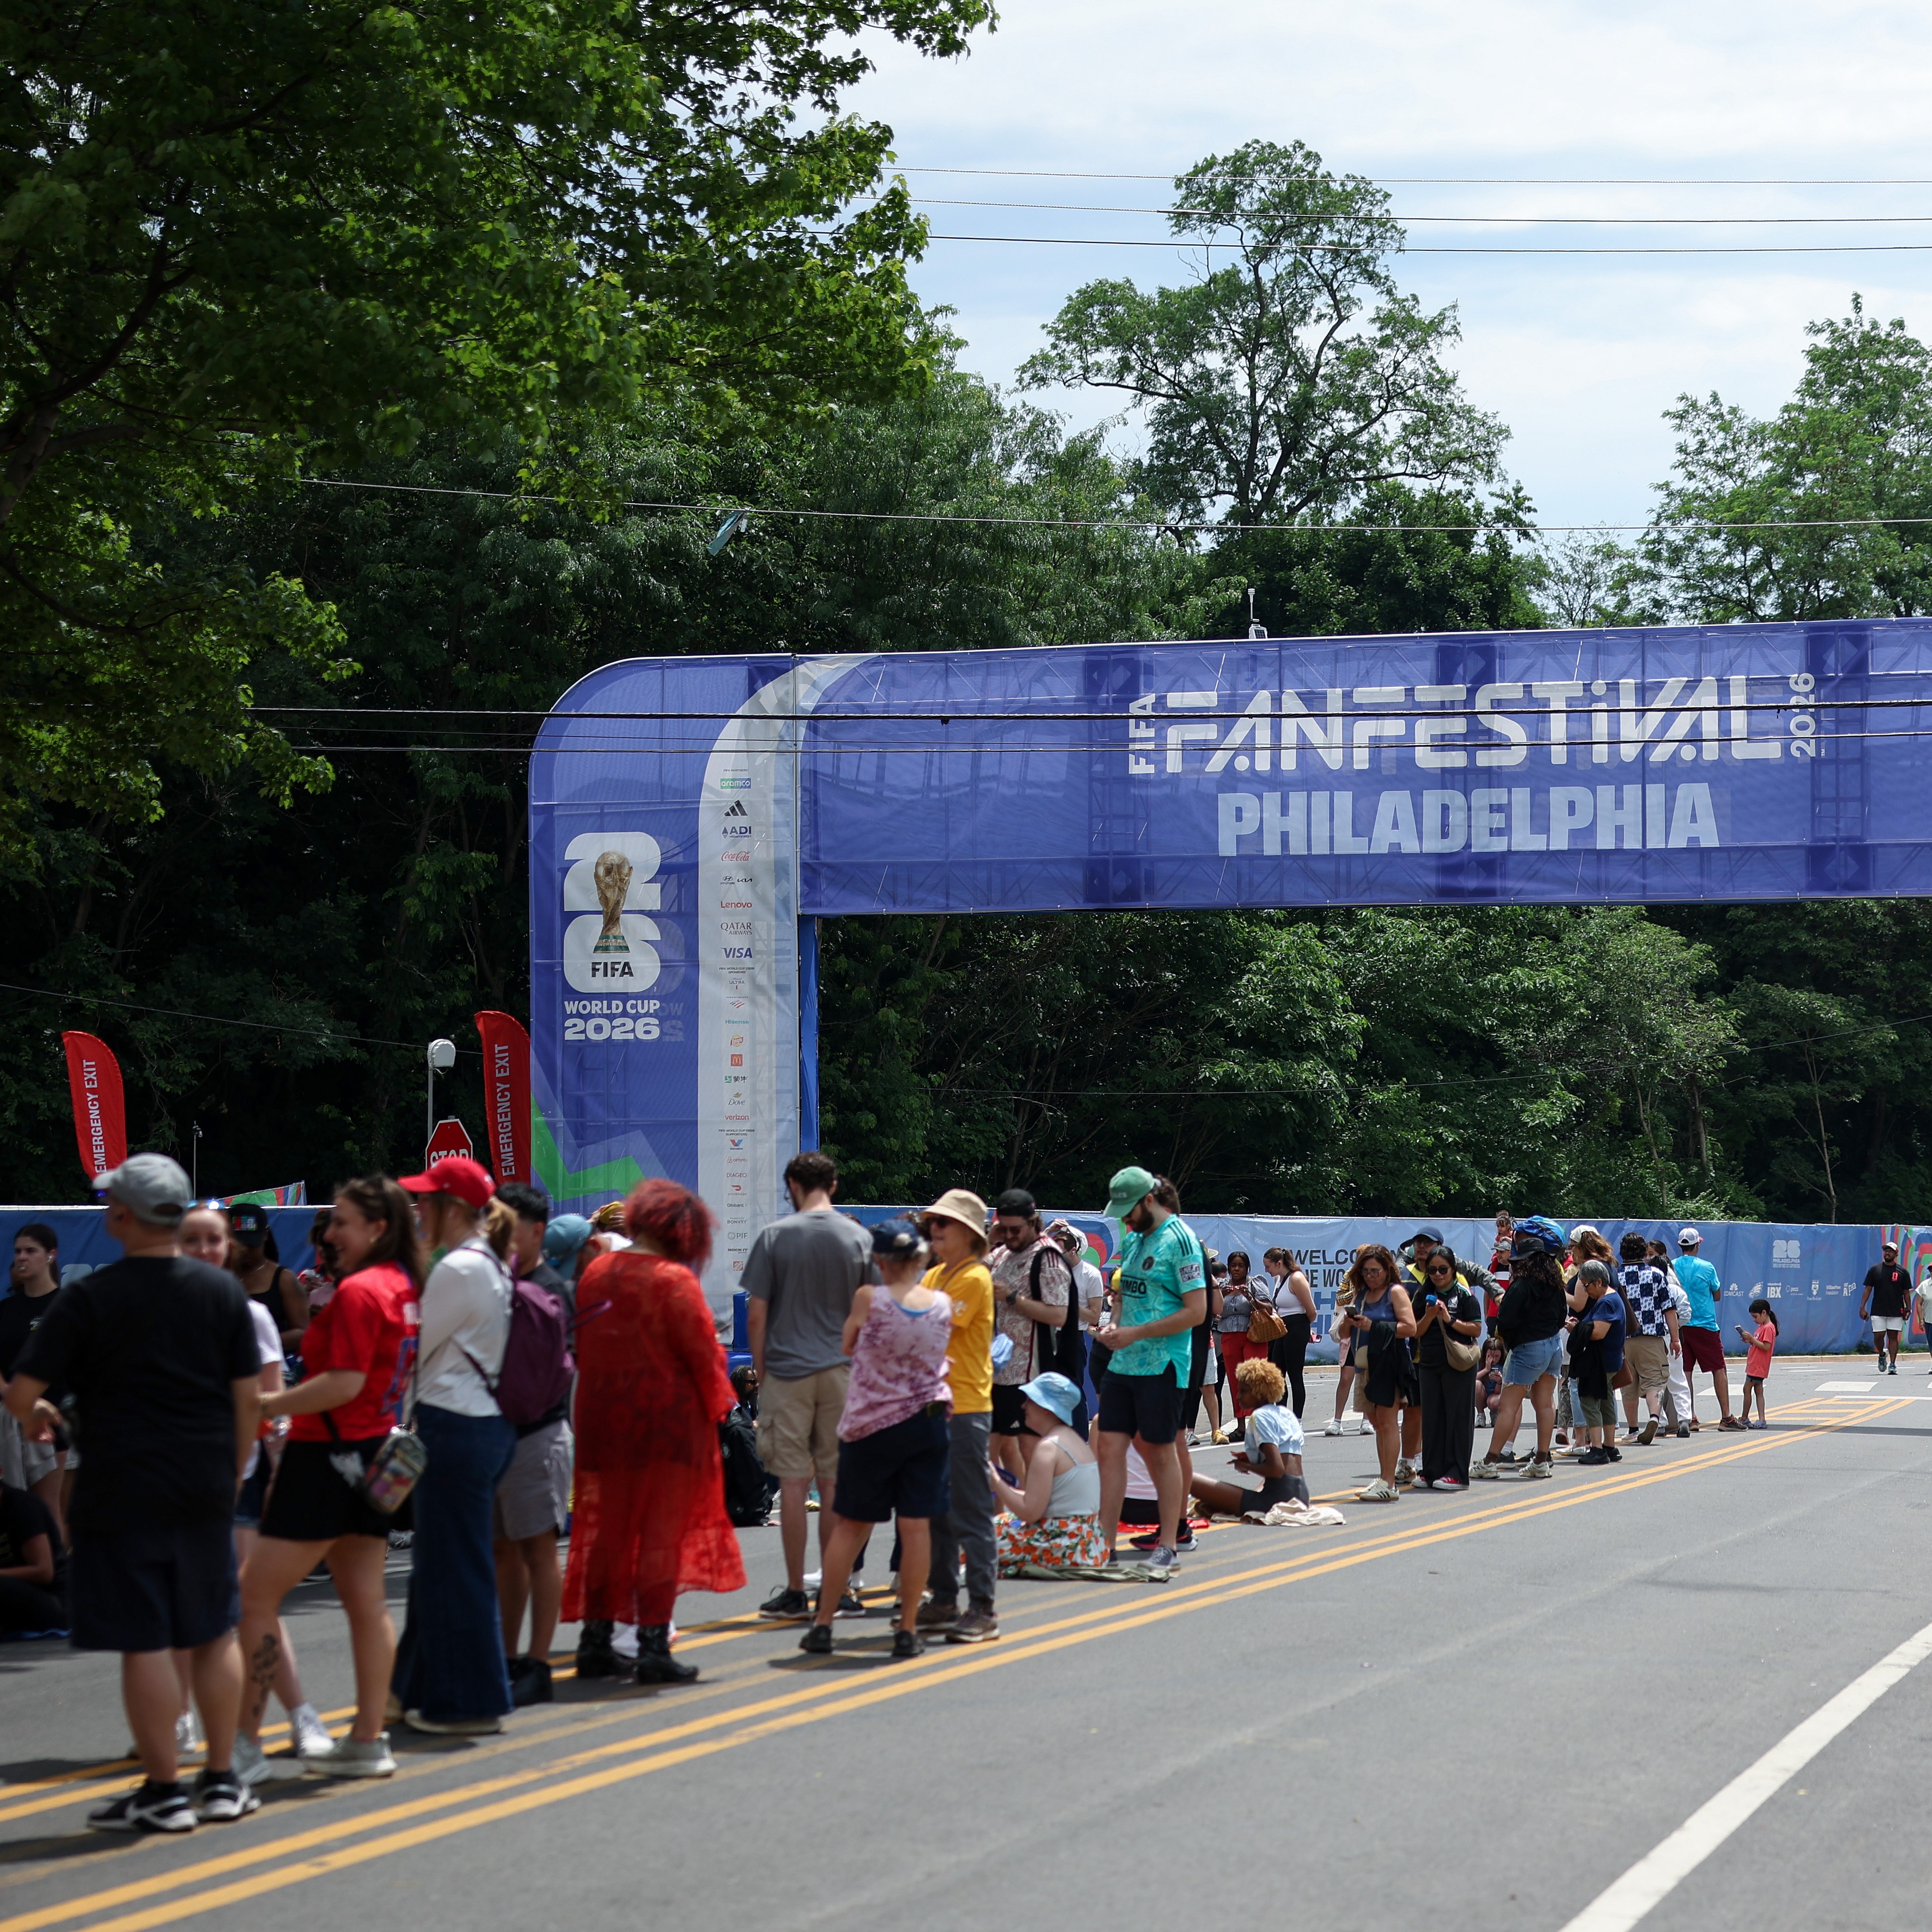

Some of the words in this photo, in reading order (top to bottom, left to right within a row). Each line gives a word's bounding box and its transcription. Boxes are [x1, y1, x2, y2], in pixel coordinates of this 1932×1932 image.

[1789, 673, 1816, 757] 2026
[1128, 693, 1155, 774] FIFA
[1217, 782, 1720, 857] PHILADELPHIA
[729, 826, 751, 835] ADI
[721, 923, 752, 931] QATAR
[721, 947, 753, 958] VISA
[591, 962, 634, 978] FIFA
[564, 1000, 623, 1014] WORLD
[626, 999, 660, 1013] CUP
[564, 1018, 660, 1040] 2026
[494, 1044, 509, 1079] EXIT
[83, 1060, 98, 1088] EXIT
[86, 1092, 107, 1173] EMERGENCY
[496, 1082, 515, 1177] EMERGENCY
[1289, 1249, 1357, 1265] WELCO
[1121, 1279, 1147, 1295] IMBO
[1767, 1287, 1781, 1298] IBX
